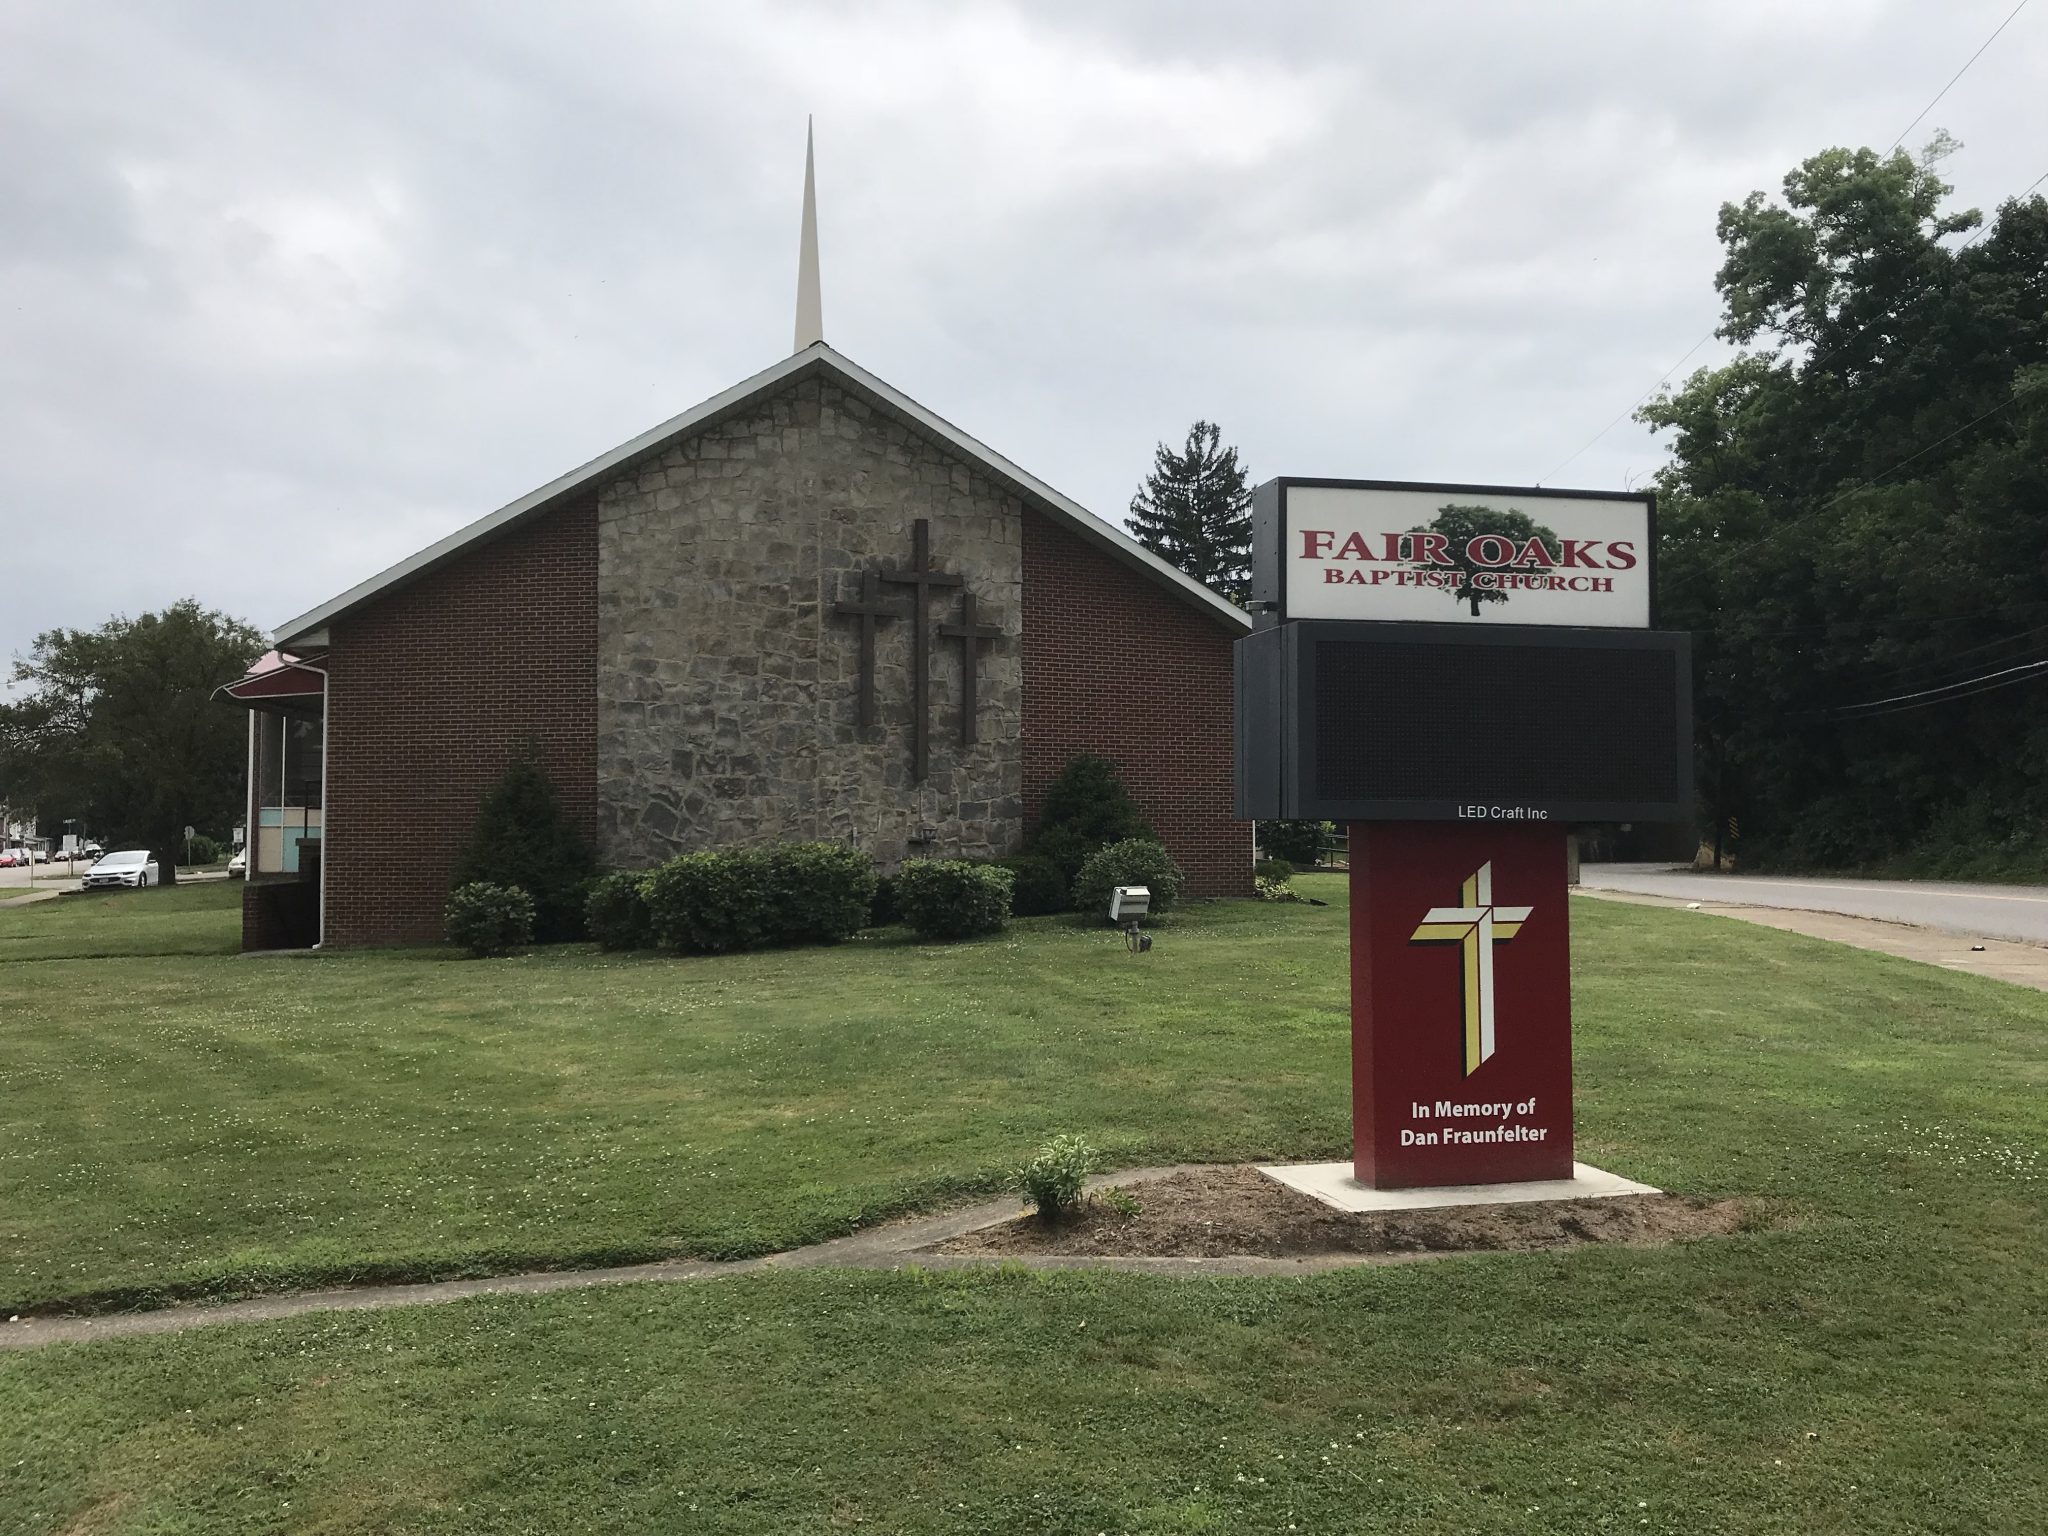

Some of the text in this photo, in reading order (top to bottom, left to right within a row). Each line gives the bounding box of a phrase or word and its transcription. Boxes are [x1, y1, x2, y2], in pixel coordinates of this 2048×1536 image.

[1299, 530, 1637, 570] FAIR OAKS
[1323, 568, 1614, 592] BAPTIST CHURCH
[1458, 805, 1548, 820] LED Craft Inc
[1412, 1097, 1536, 1120] In Memory of
[1401, 1125, 1548, 1146] Dan Fraunfelter
